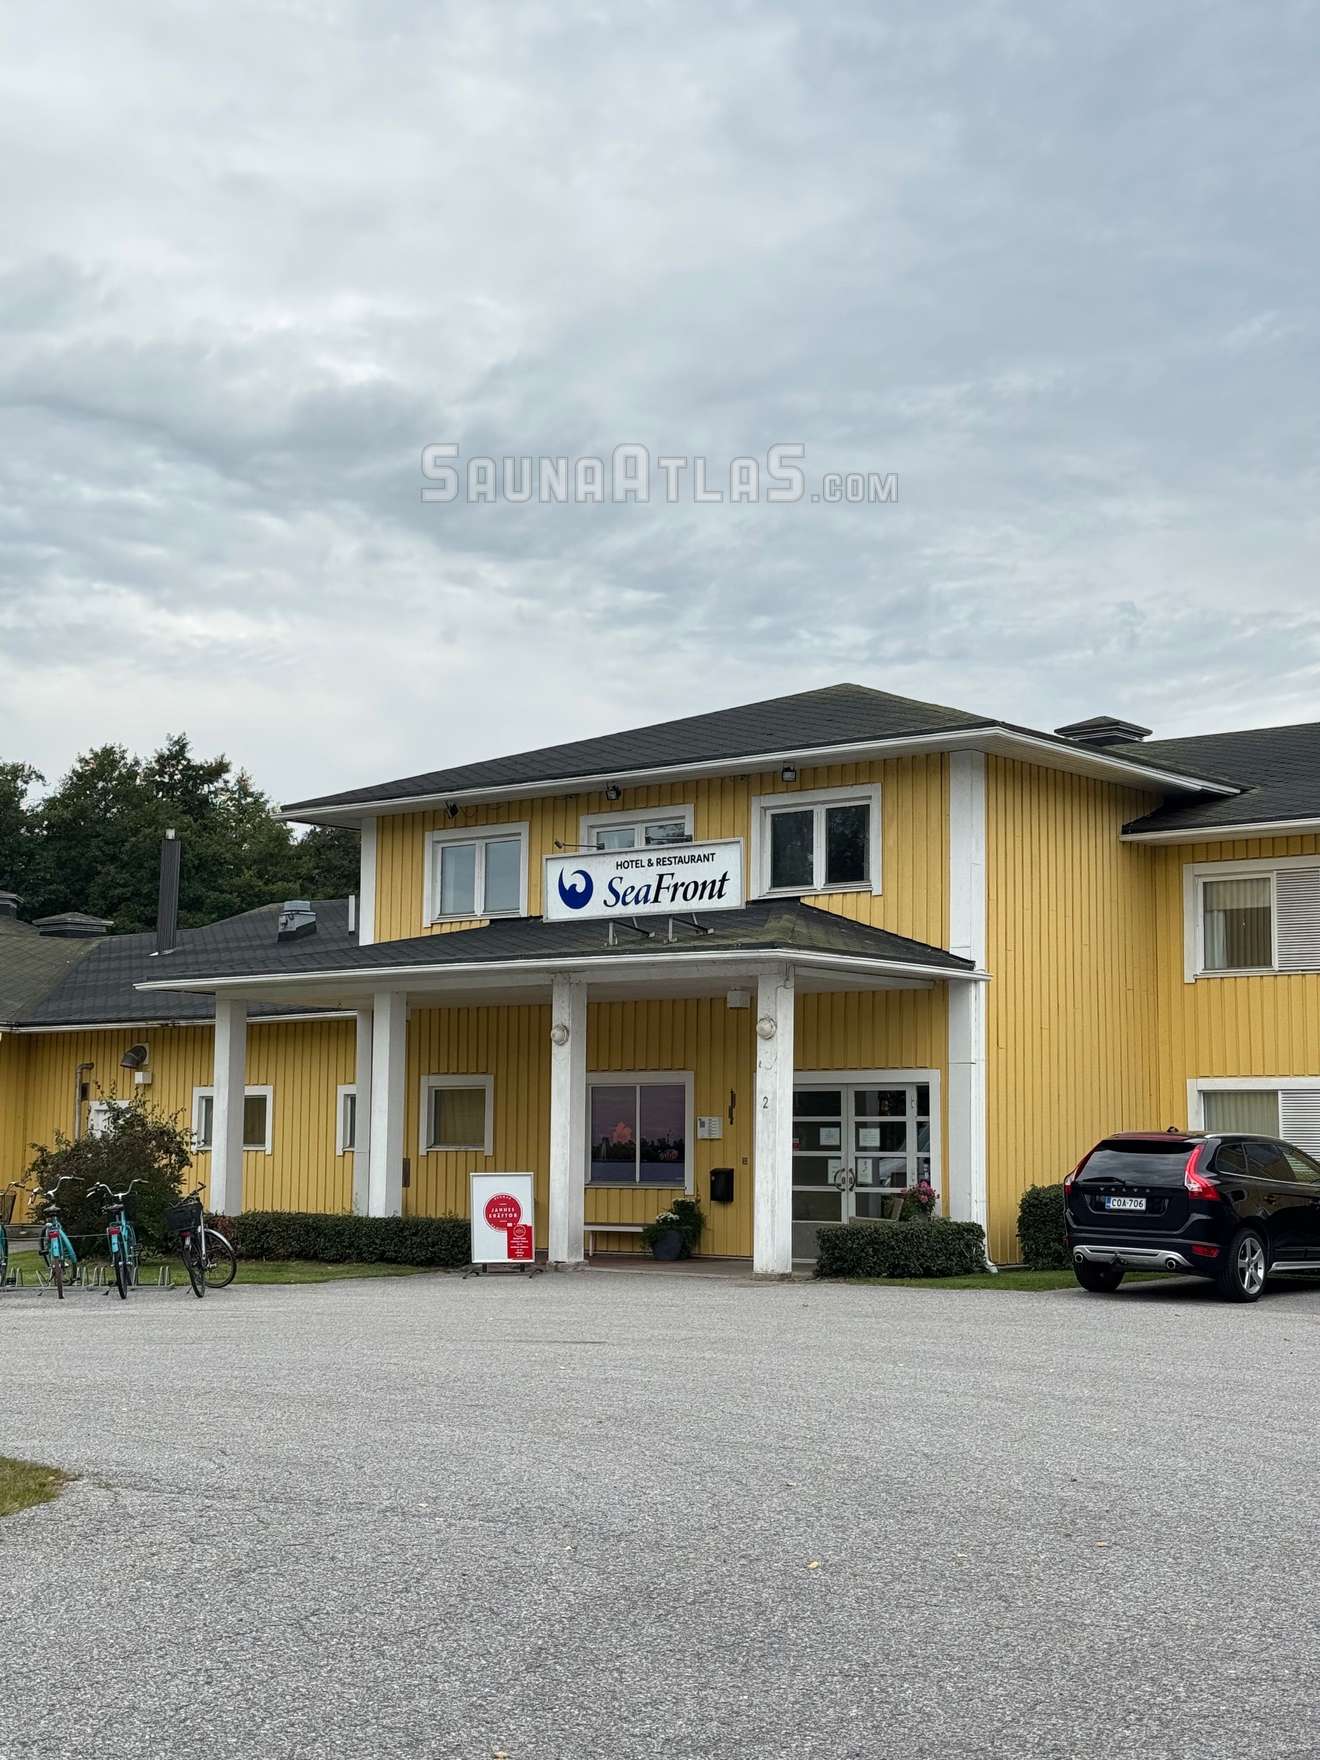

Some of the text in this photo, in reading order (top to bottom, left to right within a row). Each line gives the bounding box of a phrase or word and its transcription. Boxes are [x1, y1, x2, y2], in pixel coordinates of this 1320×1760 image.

[616, 852, 716, 870] HOTEL & RESTAURANT
[603, 870, 731, 908] SeaFront
[762, 1096, 769, 1109] 2
